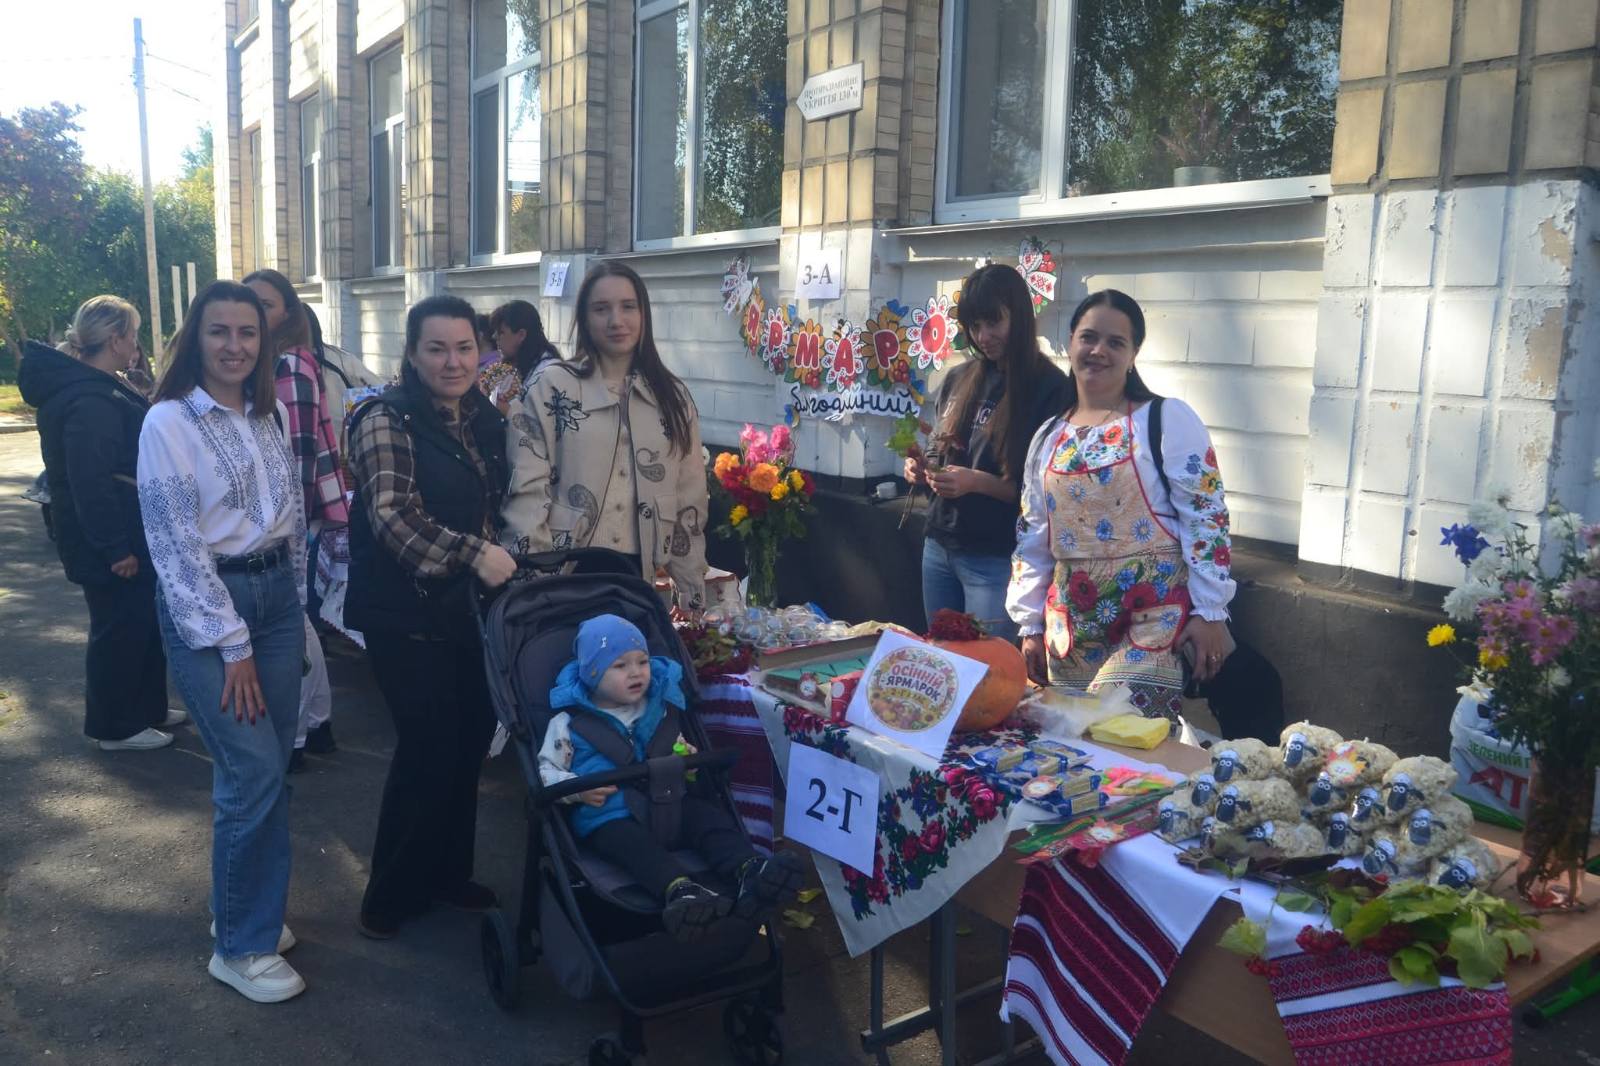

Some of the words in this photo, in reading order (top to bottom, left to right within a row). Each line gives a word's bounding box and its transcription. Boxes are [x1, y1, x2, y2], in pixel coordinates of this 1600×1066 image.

[803, 92, 837, 111] УКРИТТЯ
[802, 263, 833, 286] 3-А
[746, 312, 948, 377] ЯРМАРО
[886, 675, 942, 702] ЯРМАРОК
[805, 778, 863, 835] 2-Г
